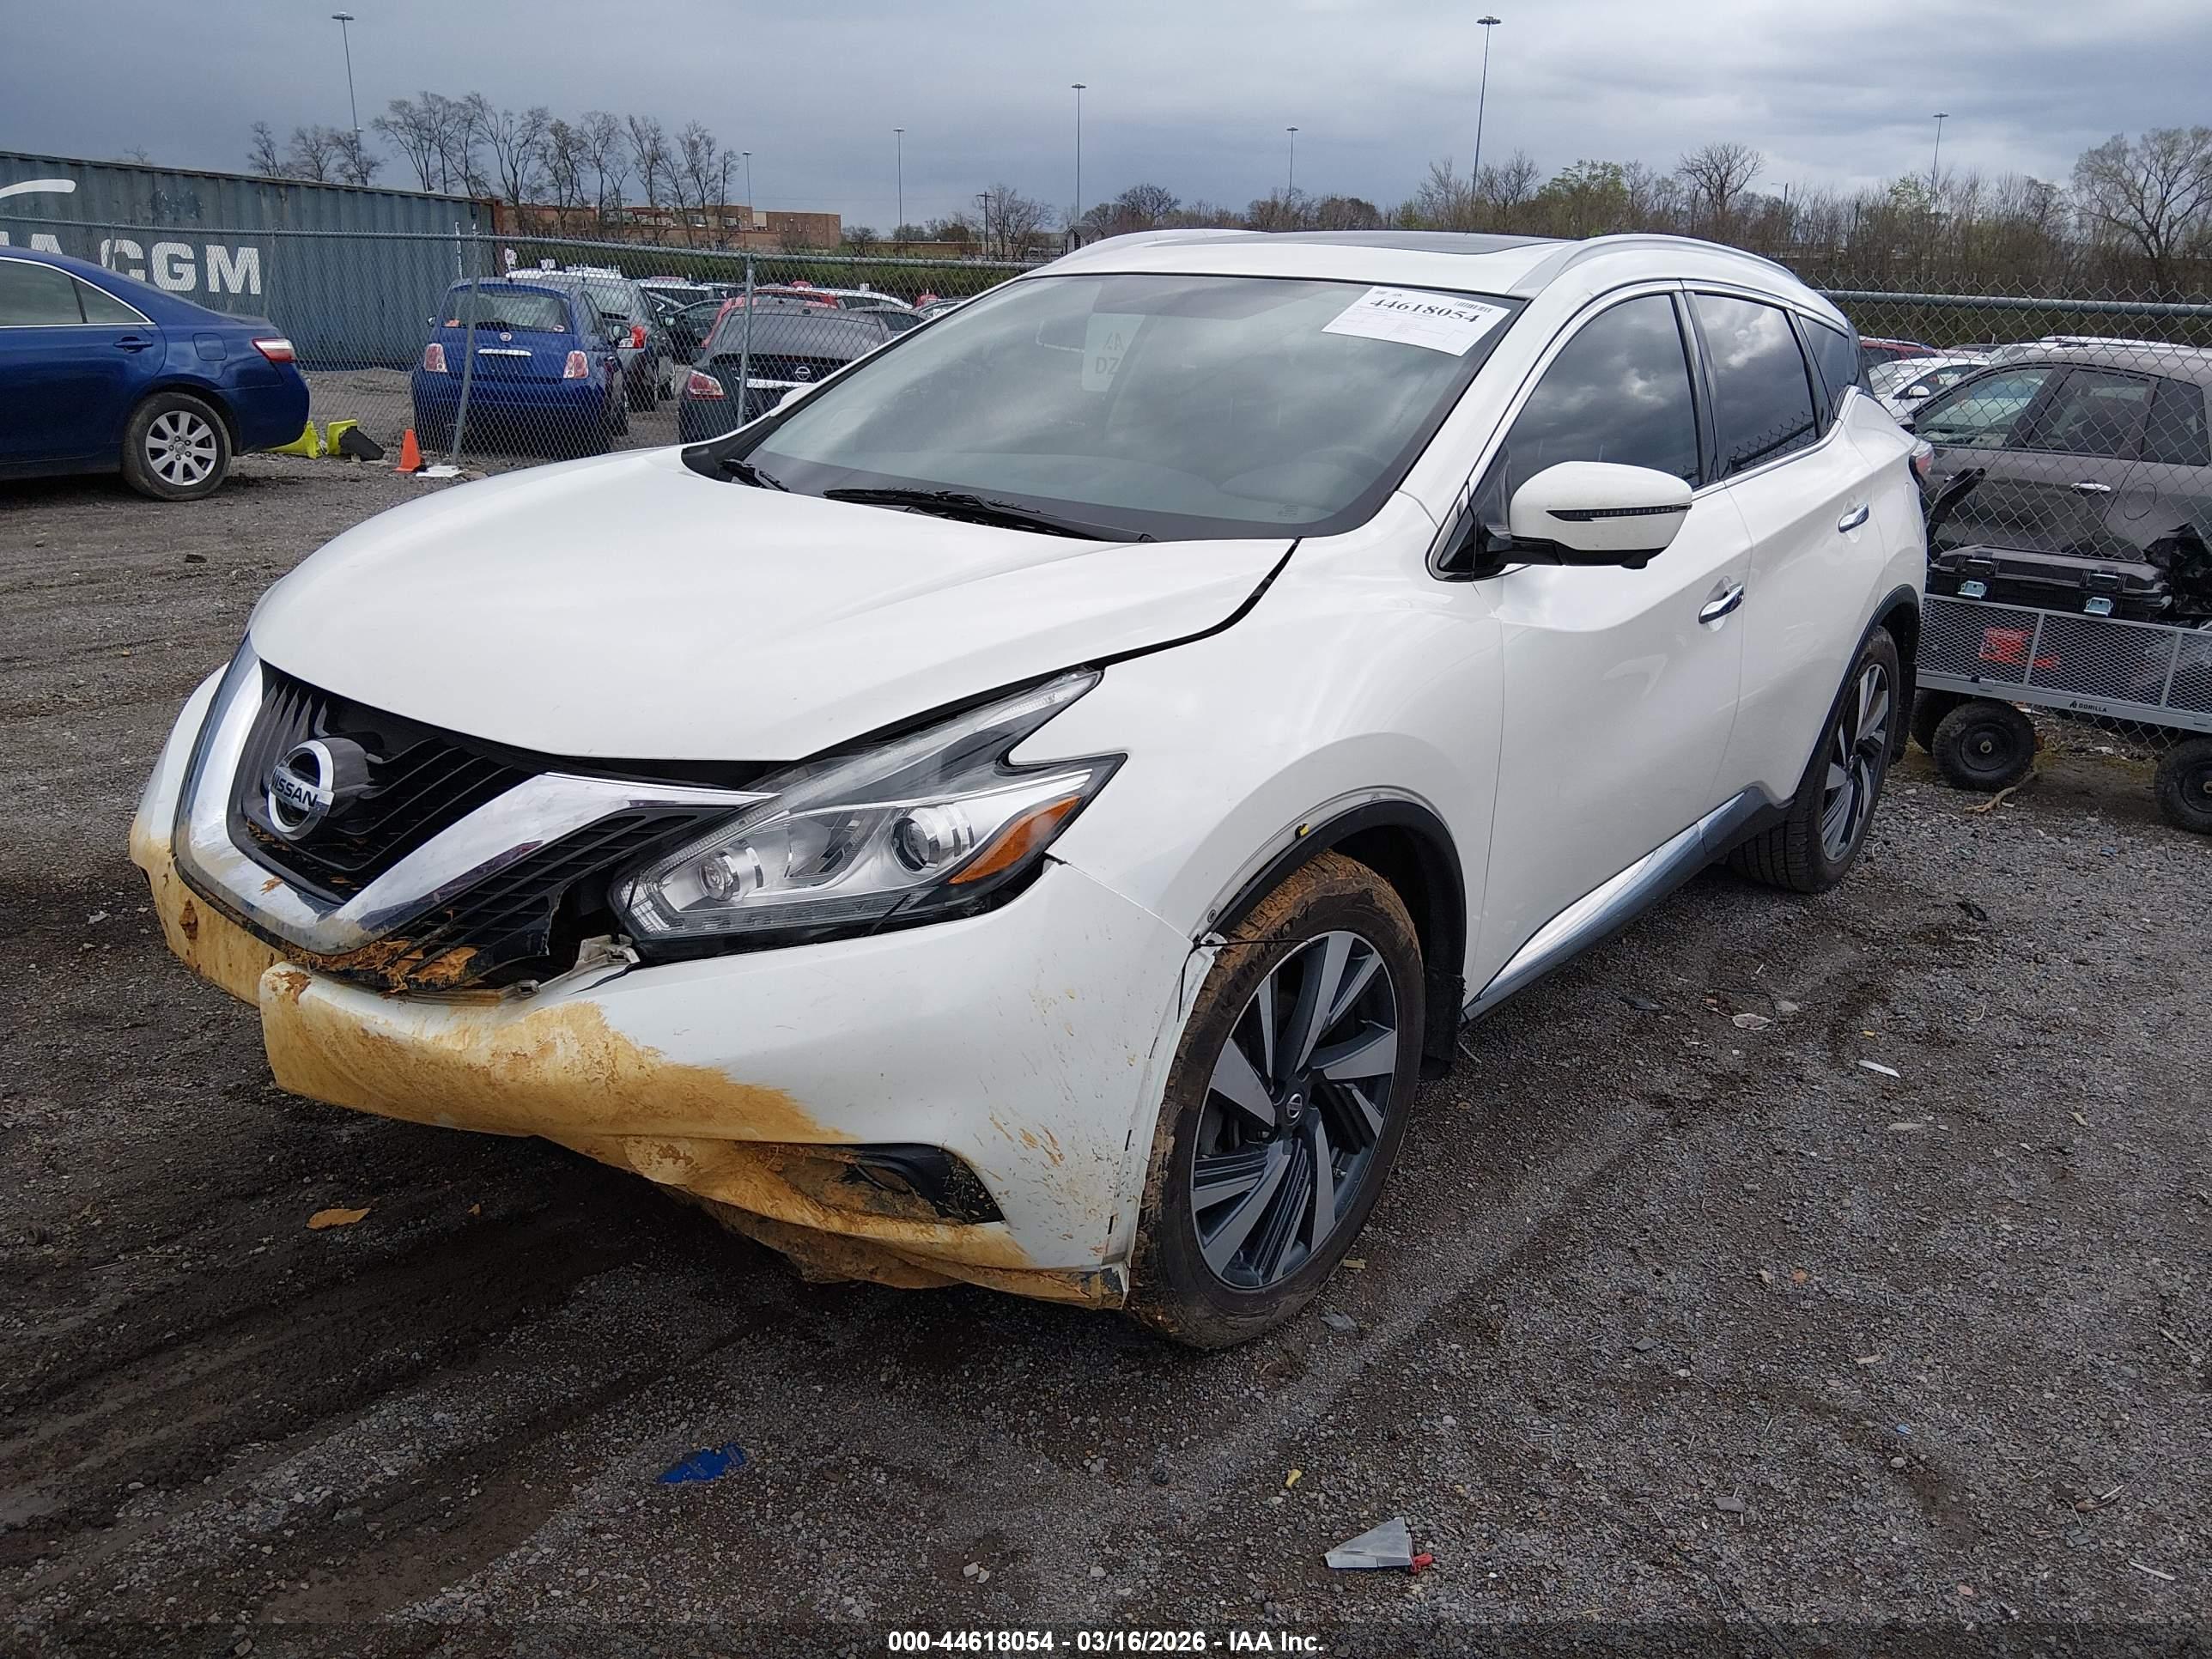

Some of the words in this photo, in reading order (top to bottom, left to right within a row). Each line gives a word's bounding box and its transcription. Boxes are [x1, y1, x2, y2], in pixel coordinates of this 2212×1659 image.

[100, 238, 261, 295] CGM
[1370, 299, 1480, 324] 44618054
[2079, 702, 2107, 713] GORILLA
[272, 774, 319, 808] NISSAN
